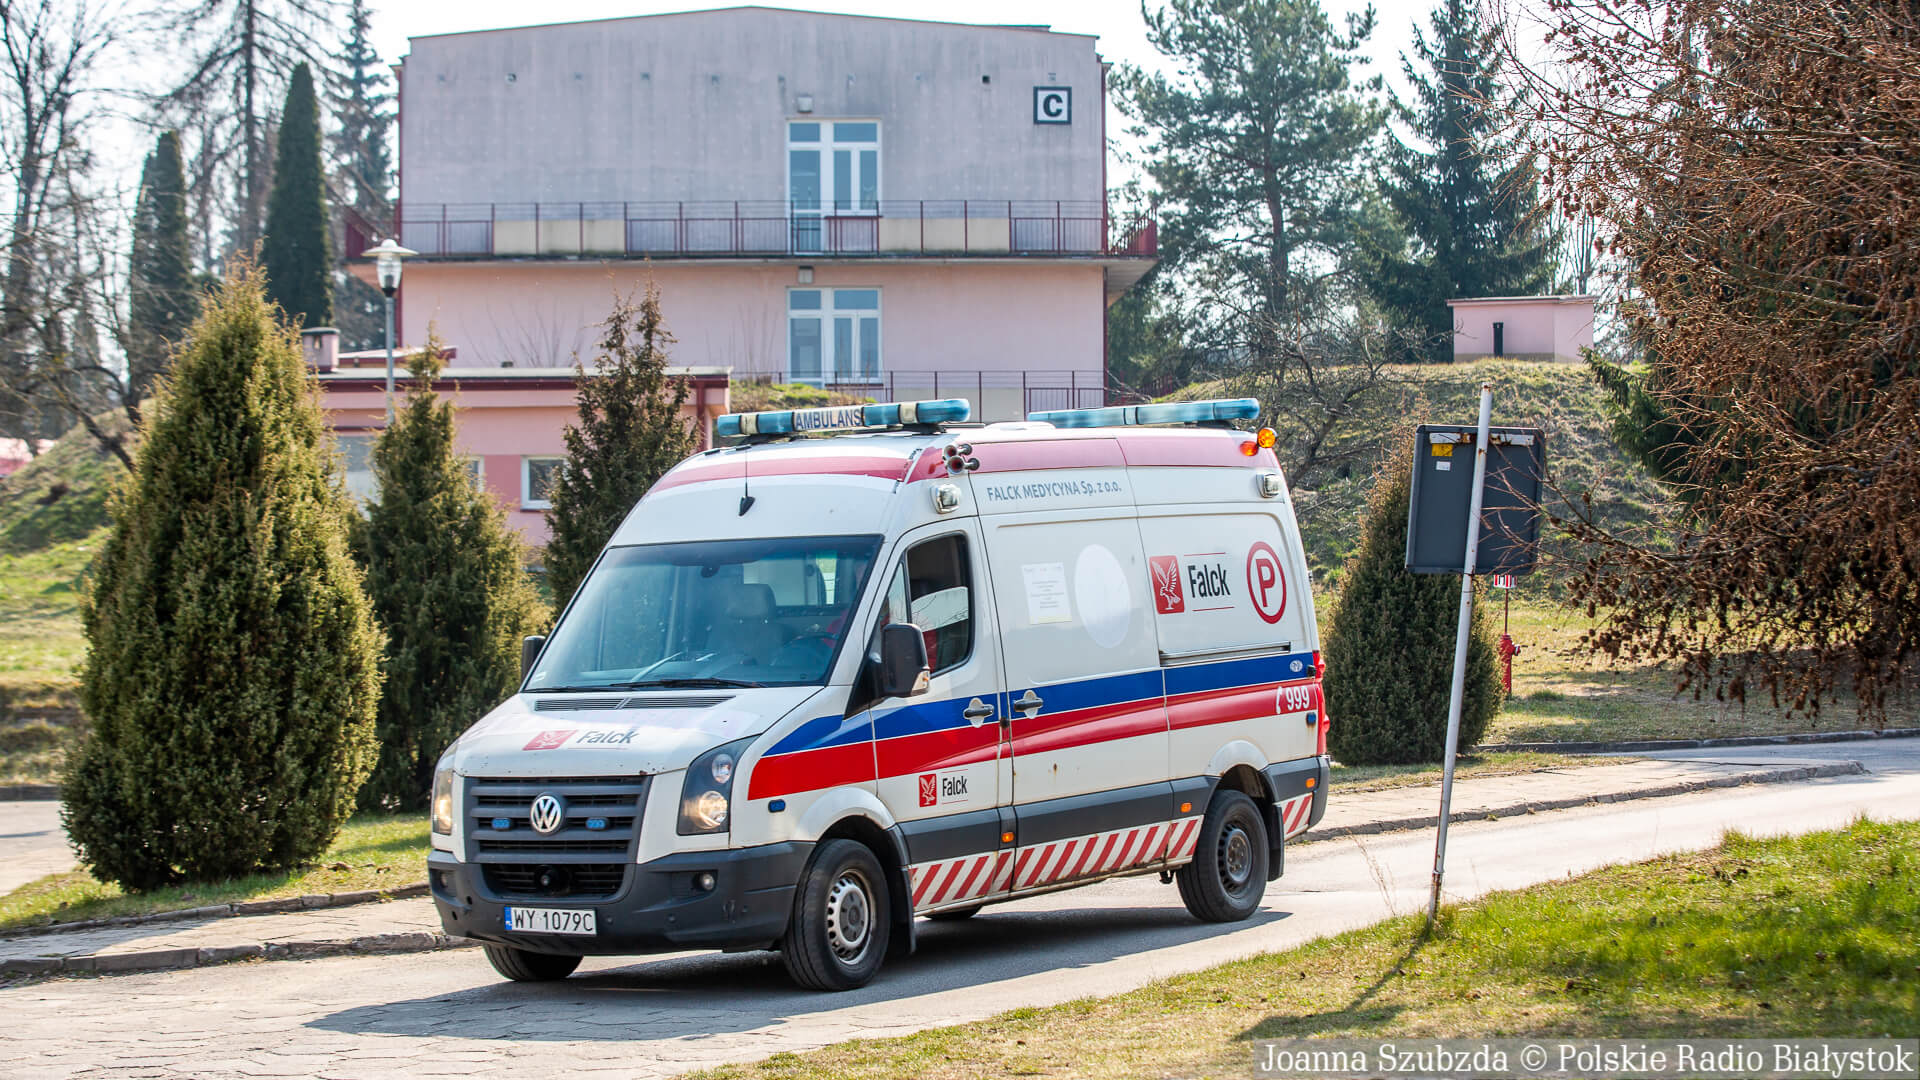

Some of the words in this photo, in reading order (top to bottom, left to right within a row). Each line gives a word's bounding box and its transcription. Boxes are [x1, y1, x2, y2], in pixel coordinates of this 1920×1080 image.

[1043, 93, 1063, 117] C
[796, 409, 862, 430] AMBULANS
[987, 484, 1022, 501] FALCK
[1023, 481, 1080, 499] MEDYCYNA
[1080, 480, 1097, 496] Sp.
[1097, 482, 1103, 493] z
[1104, 481, 1122, 492] o.o.
[1187, 563, 1231, 598] Falck
[1256, 558, 1276, 608] P
[1285, 685, 1310, 711] 999
[576, 729, 640, 744] Falck
[942, 775, 968, 797] Falck
[513, 909, 535, 929] WY
[543, 911, 594, 932] 1079C
